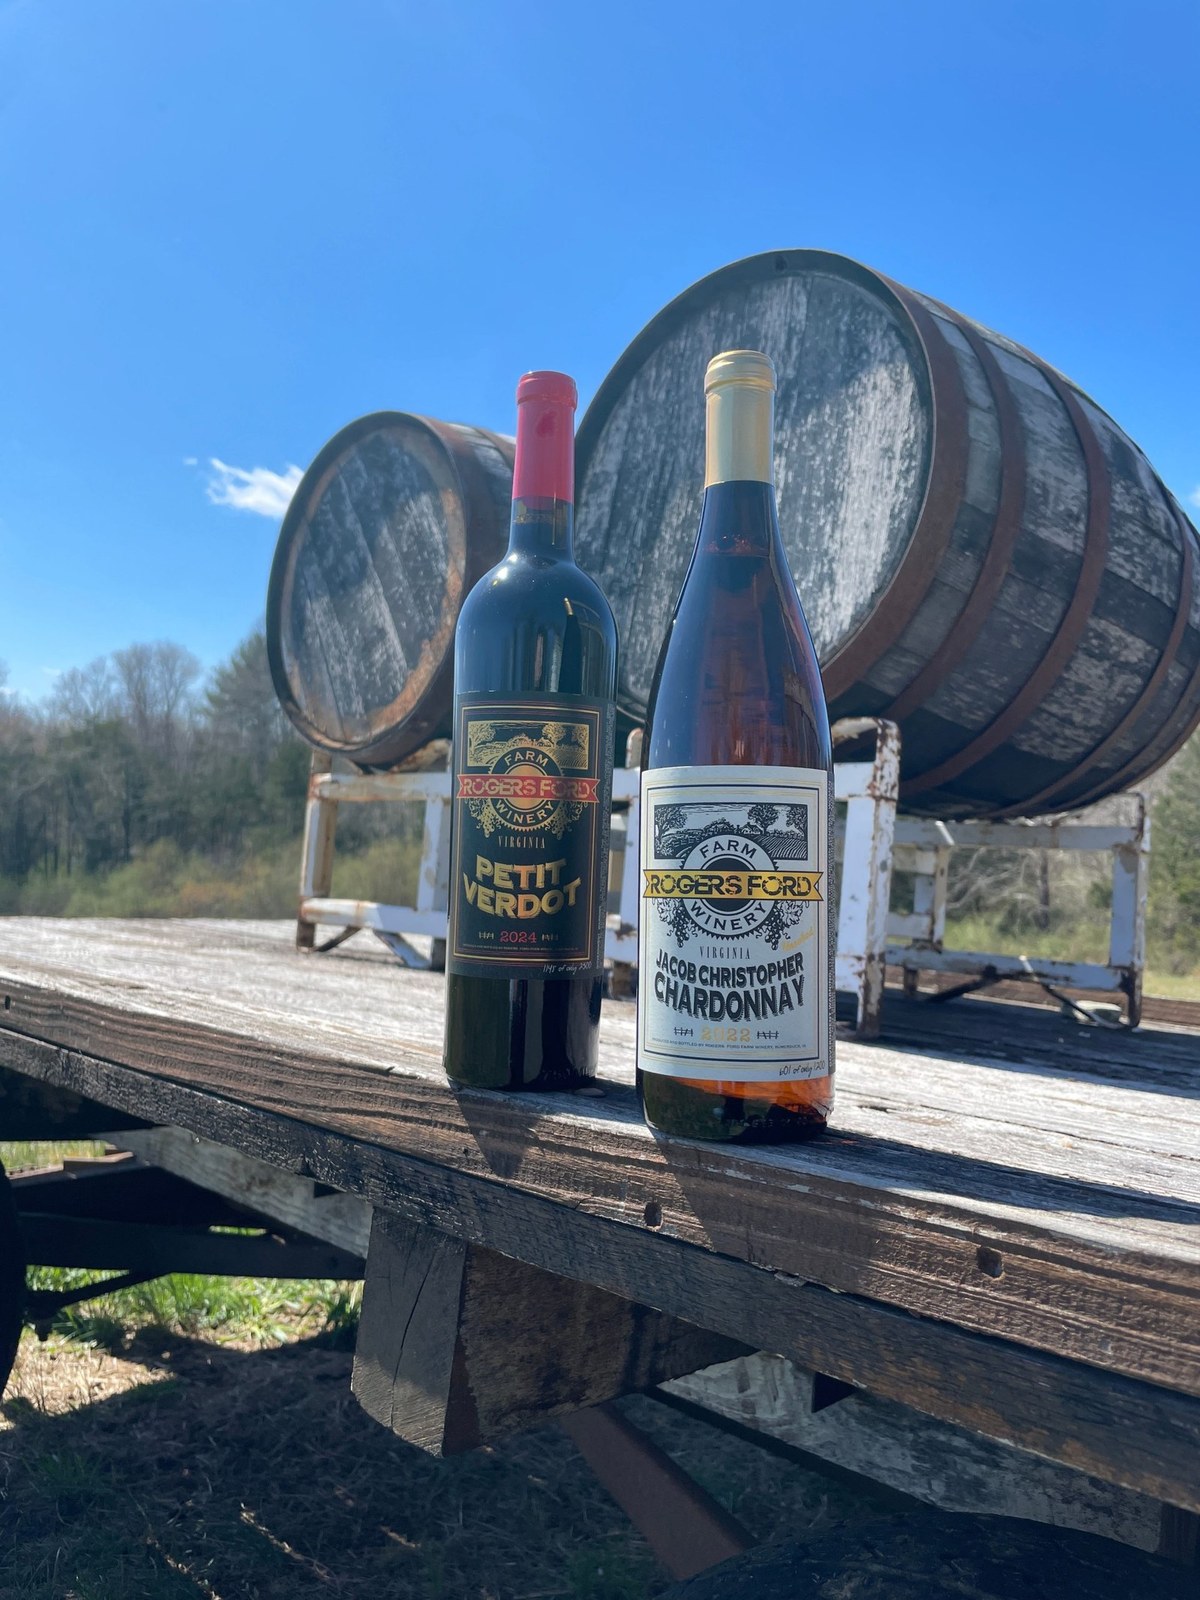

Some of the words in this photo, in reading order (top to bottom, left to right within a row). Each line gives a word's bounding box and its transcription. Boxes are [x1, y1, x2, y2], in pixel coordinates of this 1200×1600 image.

[504, 750, 548, 767] FARM
[463, 778, 537, 796] ROGERS
[540, 779, 590, 799] FORD
[495, 802, 554, 824] WINERY
[498, 835, 546, 848] VIRGINIA
[699, 839, 757, 859] FARM
[475, 854, 567, 890] PETIT
[463, 871, 582, 919] VERDOT
[650, 874, 743, 896] ROGERS
[747, 875, 812, 897] FORD
[690, 901, 766, 931] WINERY
[500, 931, 537, 943] 2024
[699, 945, 751, 960] VIRGINIA
[656, 949, 697, 984] JACOB
[699, 951, 805, 989] CHRISTOPHER
[654, 971, 806, 1022] CHARDONNAY
[702, 1026, 751, 1042] 2022
